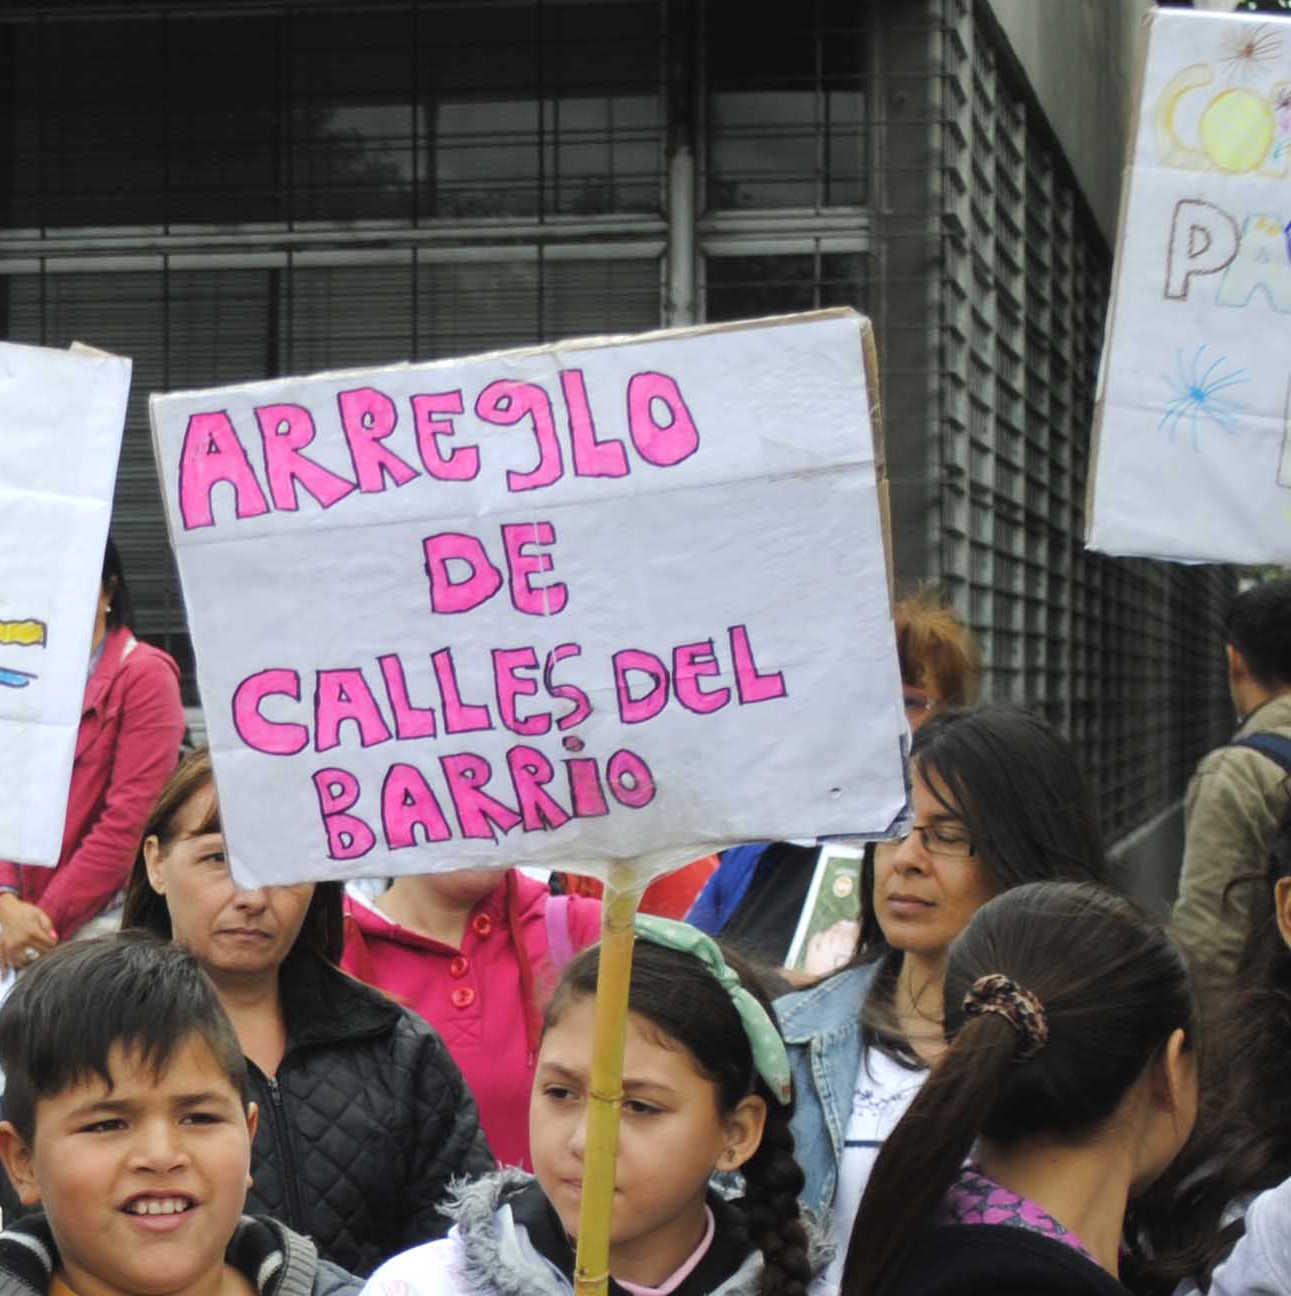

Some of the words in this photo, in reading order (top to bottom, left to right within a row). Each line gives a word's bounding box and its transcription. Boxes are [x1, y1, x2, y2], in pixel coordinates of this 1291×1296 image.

[1164, 198, 1291, 313] PA
[424, 520, 569, 616] DE
[231, 643, 593, 756] CALLES
[611, 624, 788, 725] DEL
